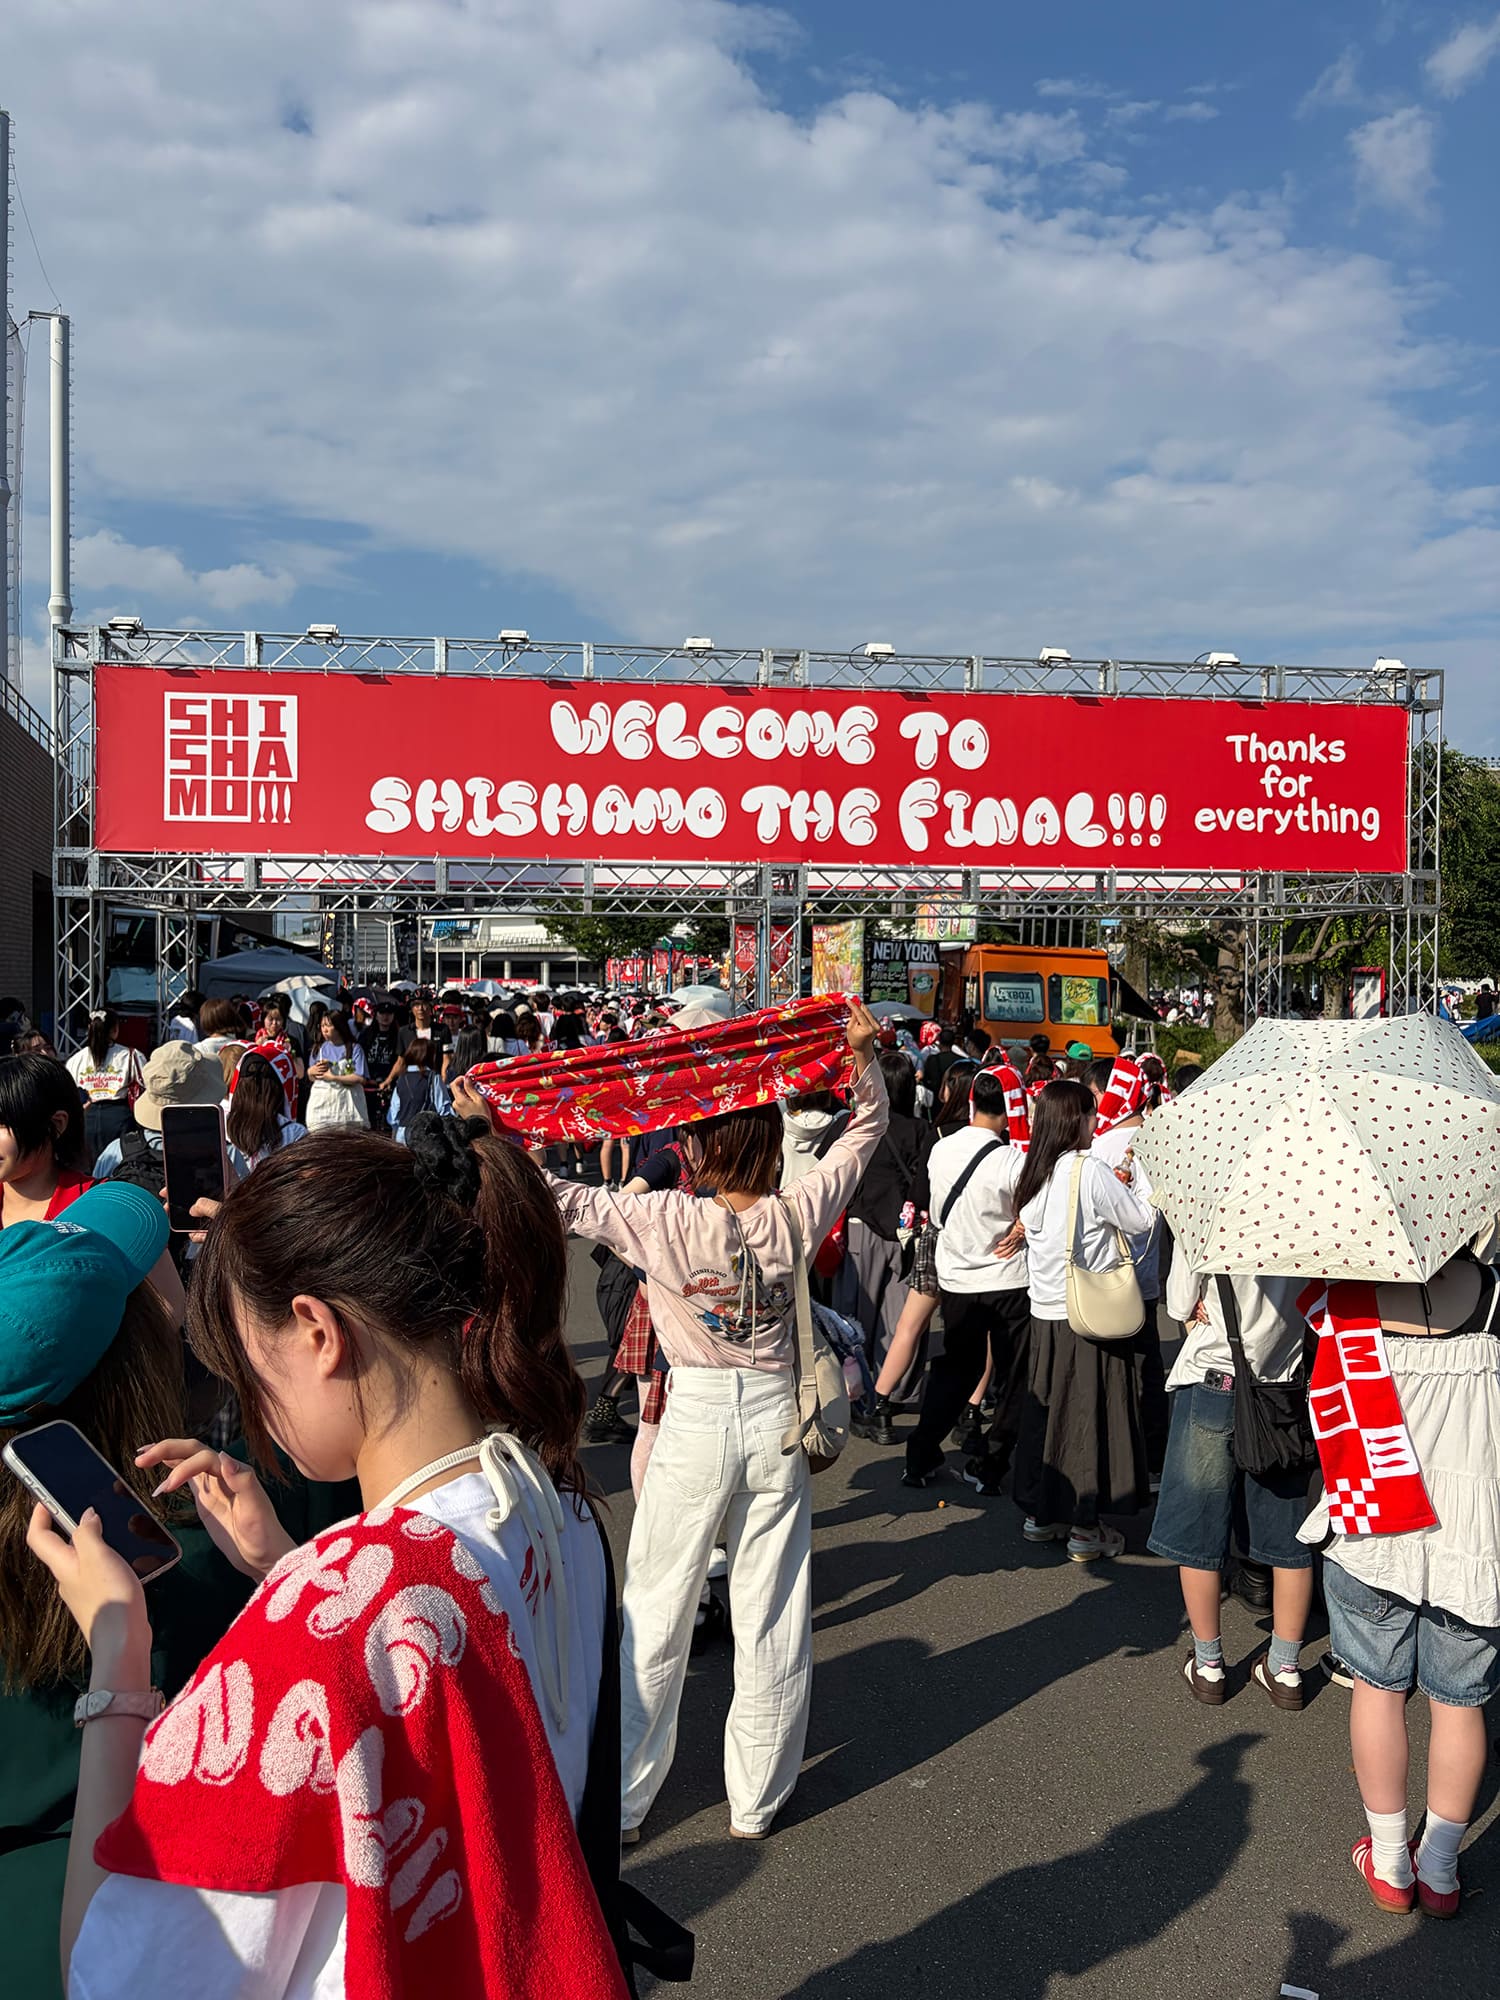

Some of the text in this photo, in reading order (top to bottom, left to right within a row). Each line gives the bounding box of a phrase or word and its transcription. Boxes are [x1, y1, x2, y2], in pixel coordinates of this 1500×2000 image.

[551, 700, 989, 770] WELCOME TO
[1226, 732, 1346, 763] Thanks
[1259, 764, 1313, 798] for
[365, 777, 1167, 851] SHISHAMO THE FINAL!!!
[1195, 801, 1380, 841] everything
[873, 941, 902, 960] NEW
[904, 941, 937, 962] YORK
